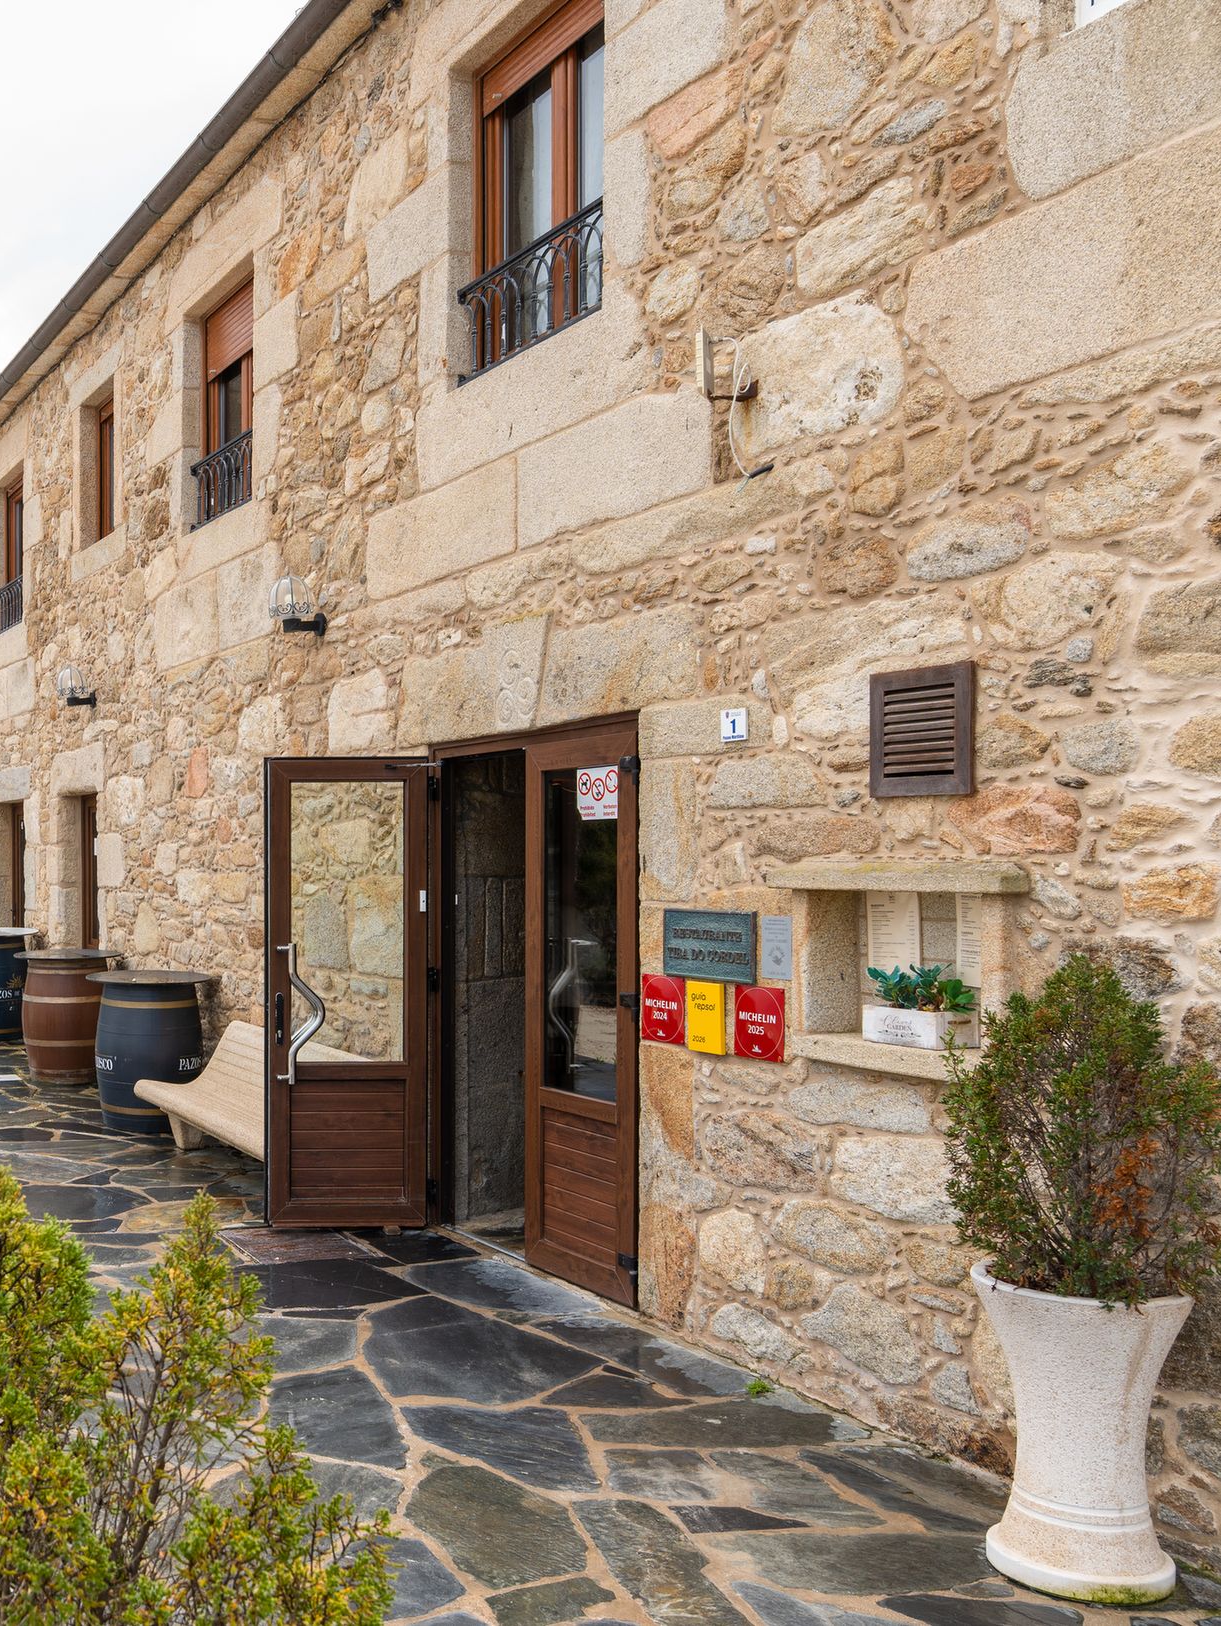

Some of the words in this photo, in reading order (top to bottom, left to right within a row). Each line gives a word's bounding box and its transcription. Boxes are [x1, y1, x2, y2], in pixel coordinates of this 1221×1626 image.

[730, 718, 736, 734] 1
[672, 927, 743, 943] RESTAURANTE
[668, 945, 690, 960] TIRA
[691, 947, 706, 962] DO
[707, 948, 750, 965] CORDEL
[645, 998, 678, 1011] MICHELIN
[694, 1002, 716, 1011] repsol
[653, 1011, 668, 1021] 2024
[738, 1011, 777, 1025] MICHELIN
[747, 1024, 765, 1036] 2025
[692, 1034, 706, 1043] 2026
